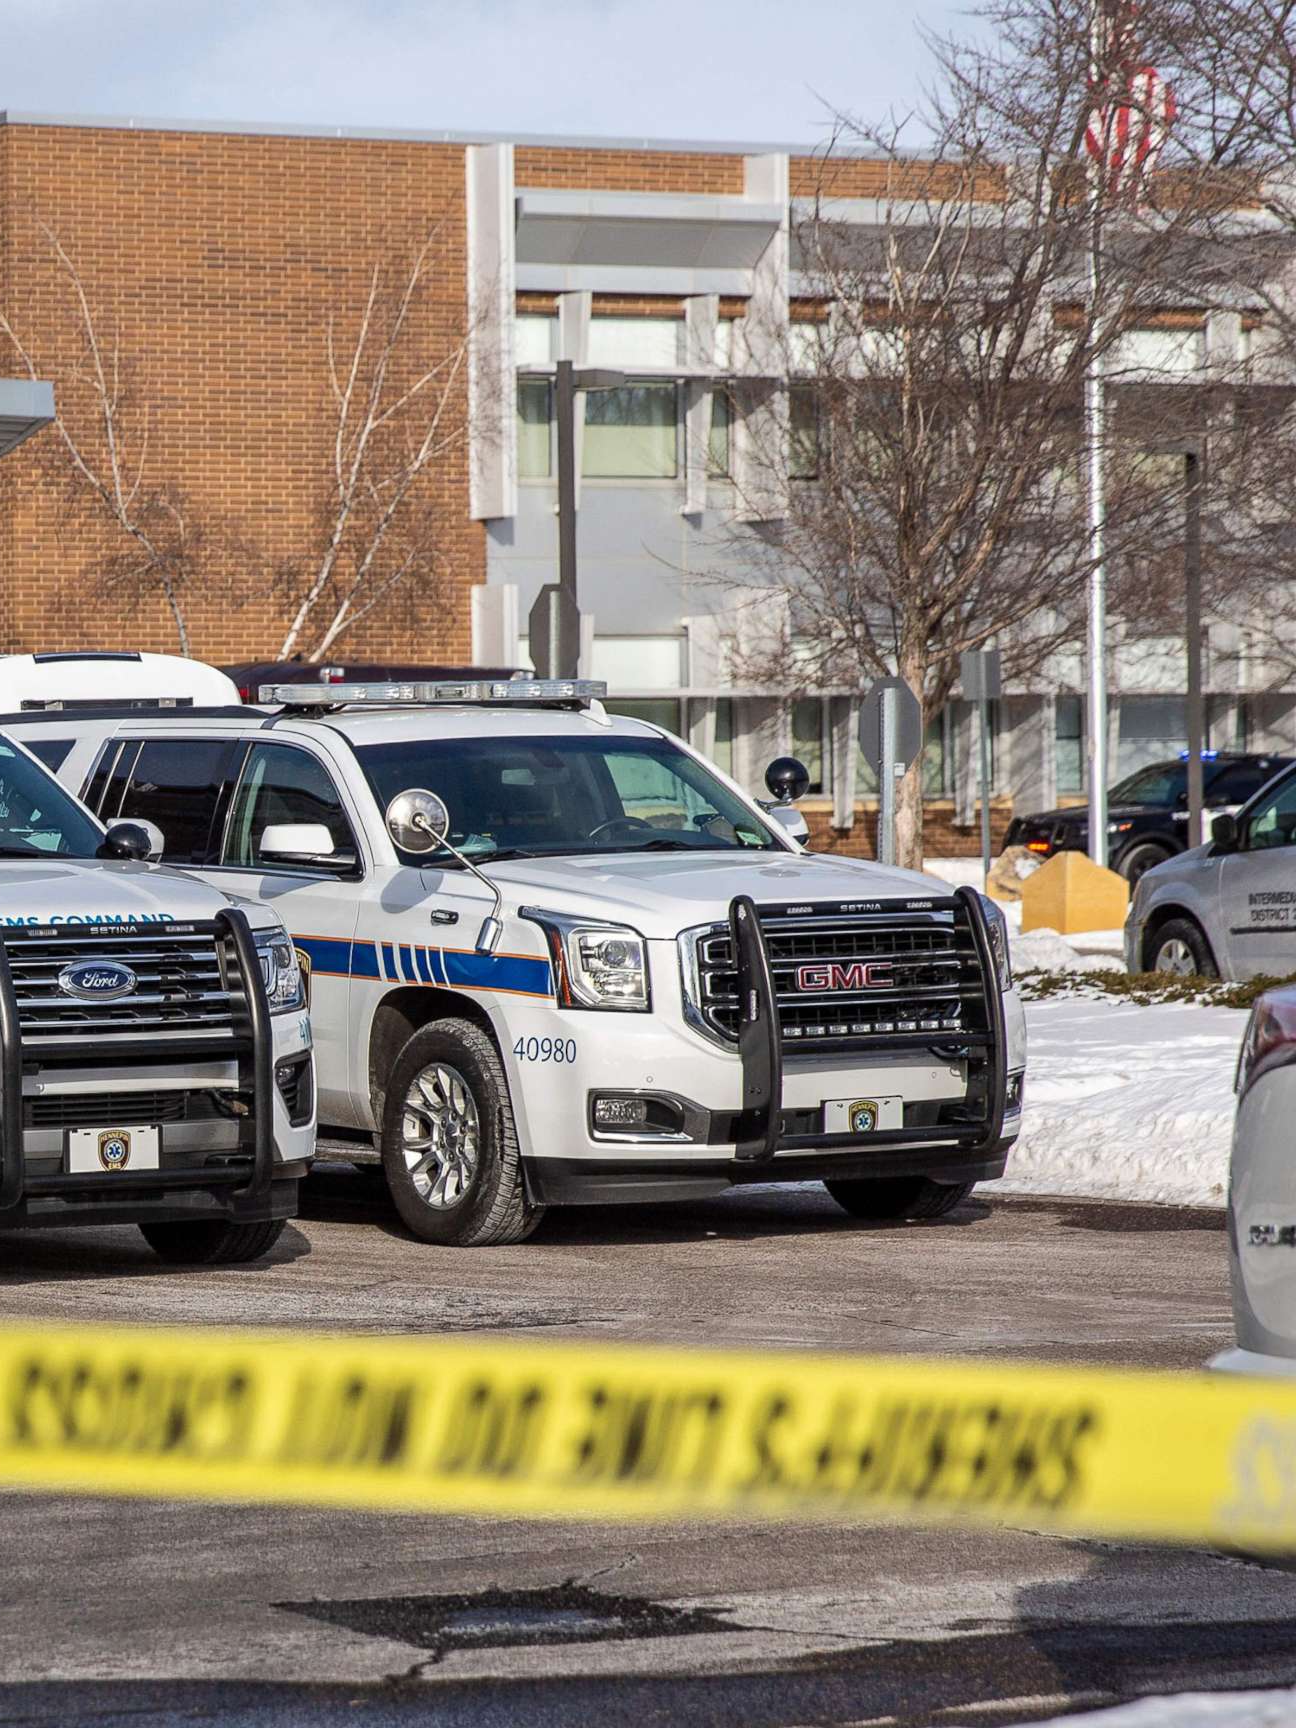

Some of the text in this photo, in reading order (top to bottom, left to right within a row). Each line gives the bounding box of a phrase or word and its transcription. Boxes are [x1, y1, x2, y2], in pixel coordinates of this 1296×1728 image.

[839, 903, 882, 912] SETINA
[89, 926, 138, 934] SETINA
[82, 971, 120, 988] Ford
[797, 962, 894, 991] GMC
[512, 1036, 577, 1064] 40980
